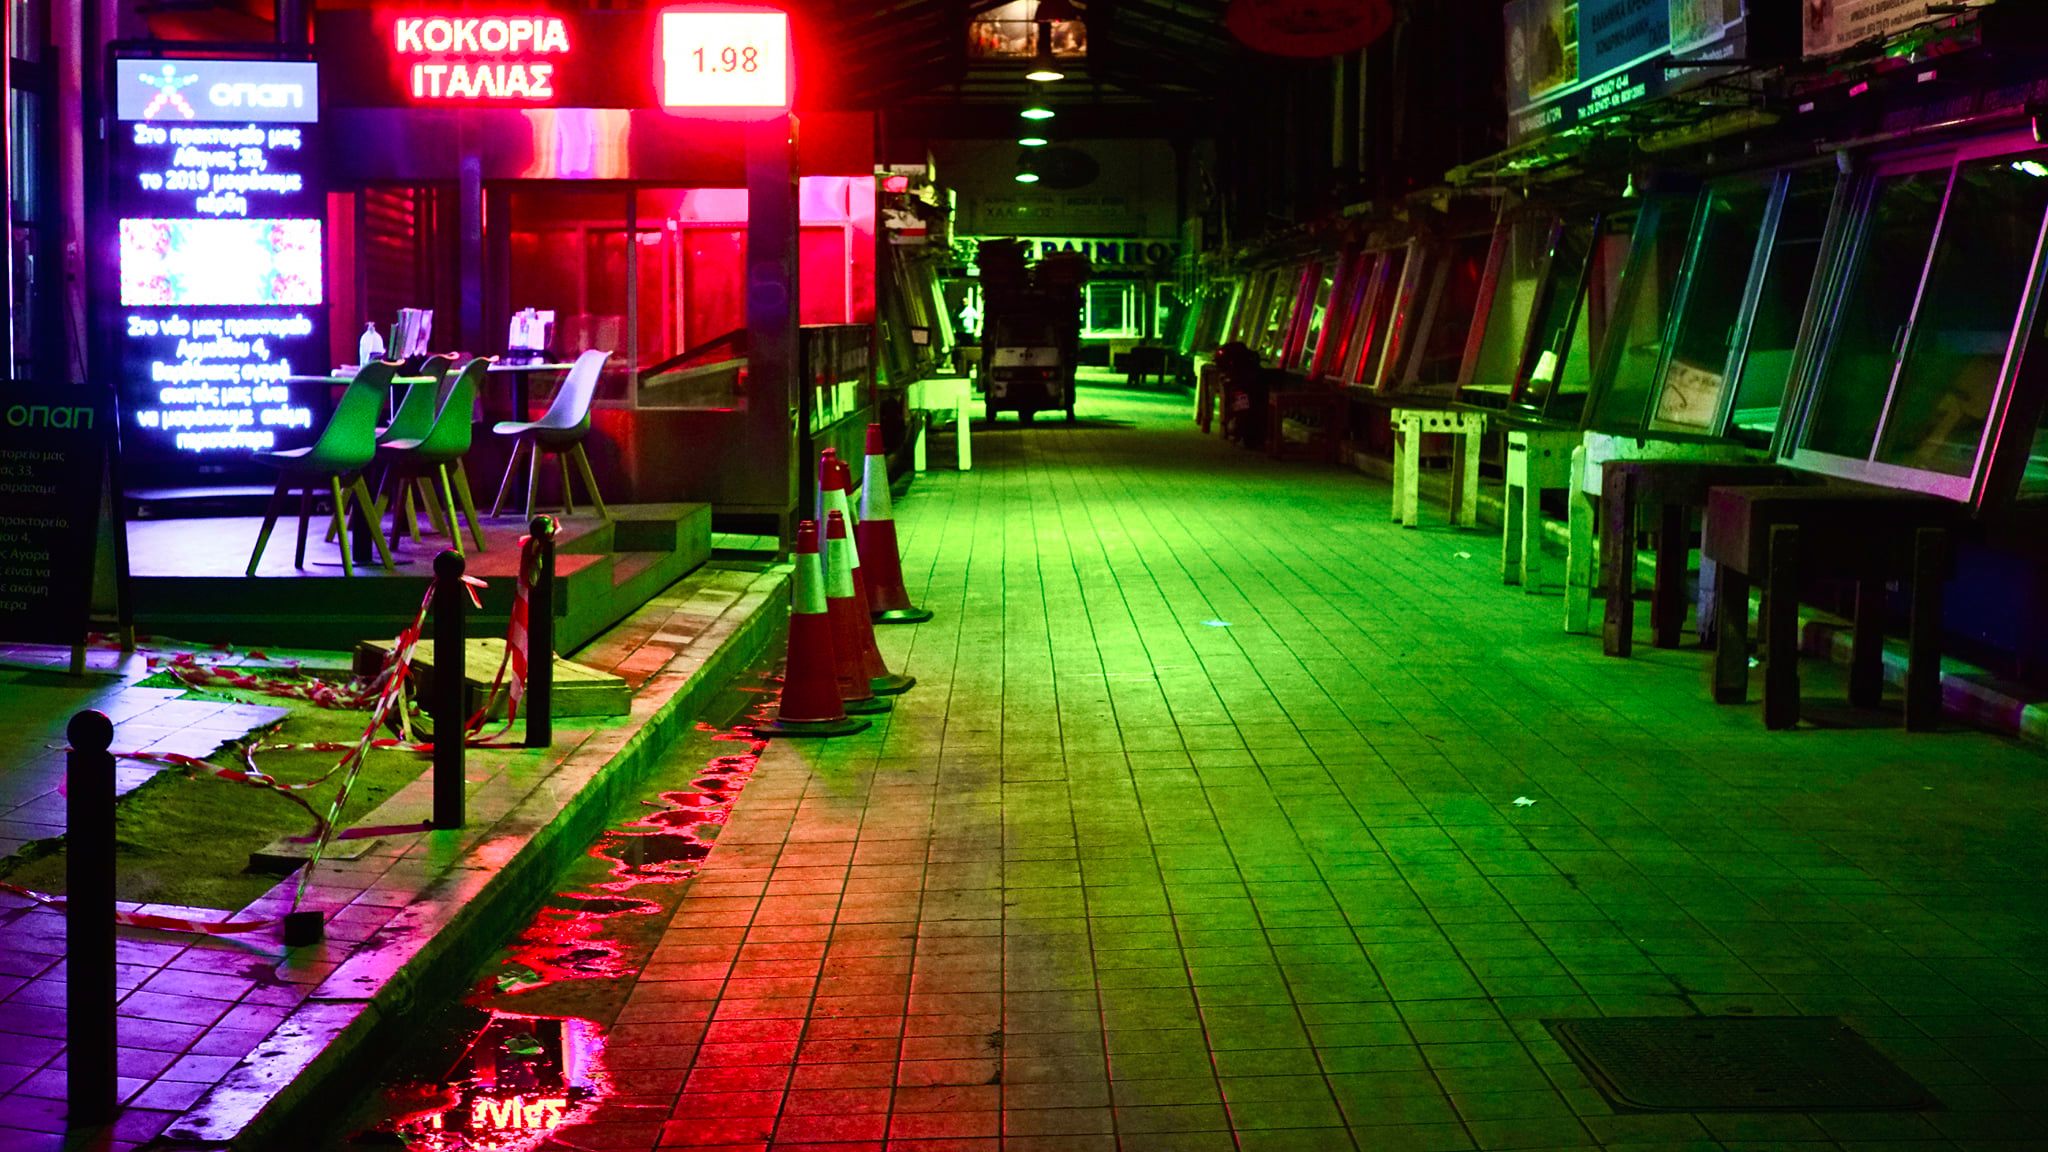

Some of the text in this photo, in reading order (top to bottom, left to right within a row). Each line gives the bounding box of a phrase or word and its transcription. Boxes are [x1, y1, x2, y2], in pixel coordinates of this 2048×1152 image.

[396, 18, 571, 54] ΚΟΚΟΡΙΑ
[692, 46, 759, 73] 1.98
[412, 63, 555, 98] ΙΤΑΛΙΑΣ
[140, 173, 163, 190] το
[165, 170, 210, 190] 2019
